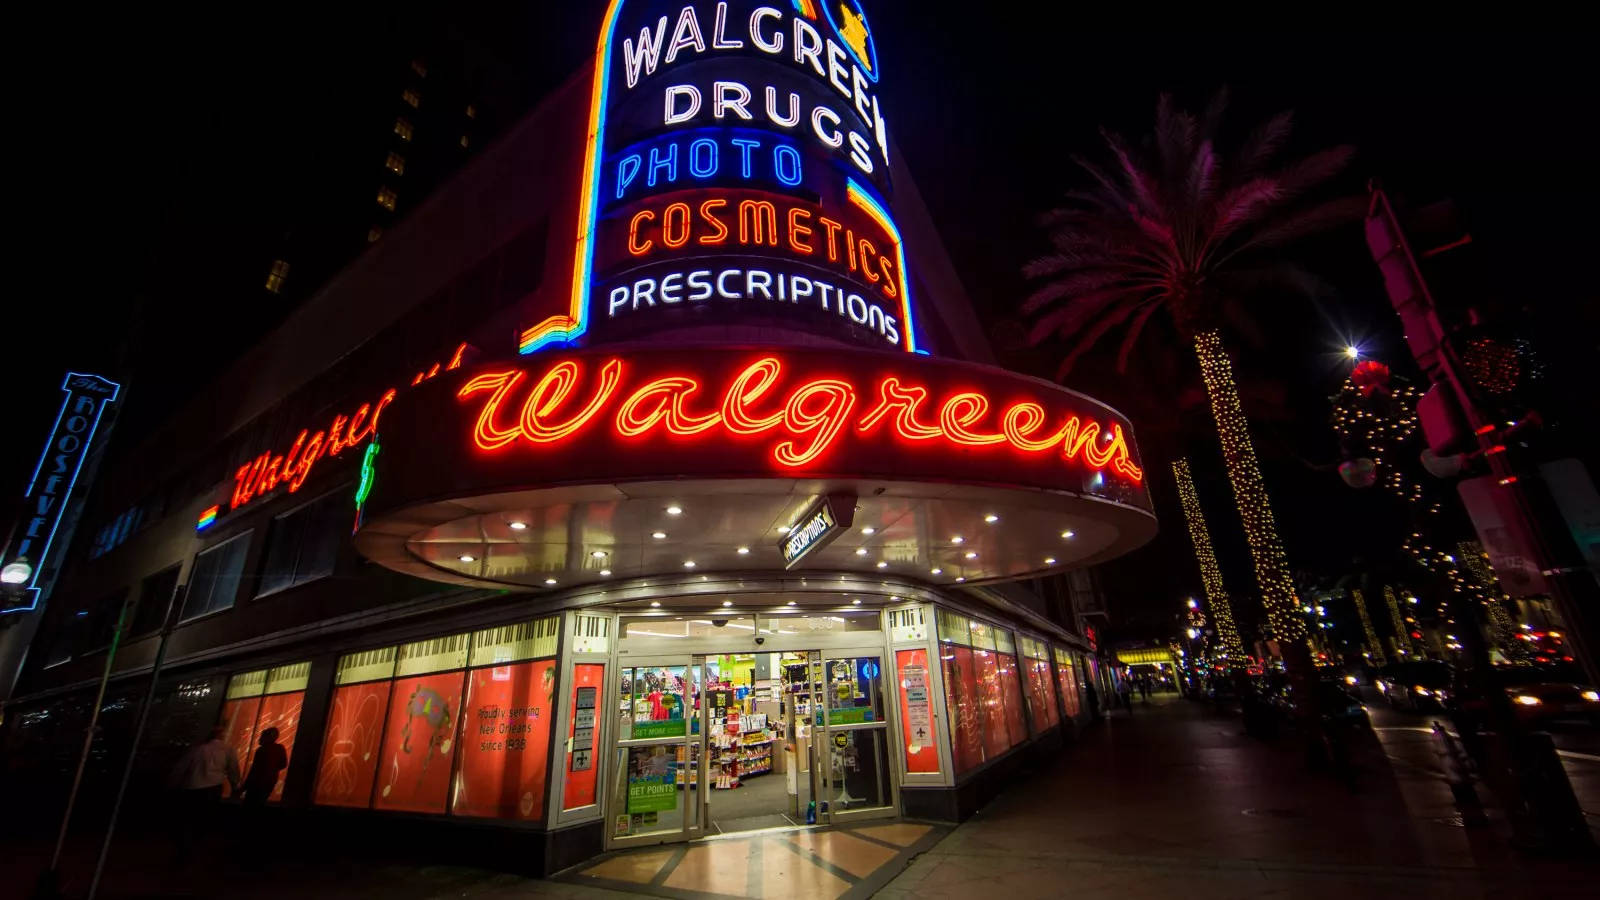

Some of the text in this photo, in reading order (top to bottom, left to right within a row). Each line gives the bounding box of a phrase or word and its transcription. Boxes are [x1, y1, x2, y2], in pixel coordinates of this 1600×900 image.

[665, 81, 873, 173] DRUGS
[617, 138, 801, 198] PHOTO
[629, 199, 897, 298] COSMETICS
[609, 269, 899, 344] PRESCRIPTIONS
[458, 357, 1143, 481] Walgreens
[480, 723, 532, 735] New Orleans
[509, 706, 540, 719] serving
[481, 741, 503, 752] since
[631, 784, 674, 796] GET POINTS
